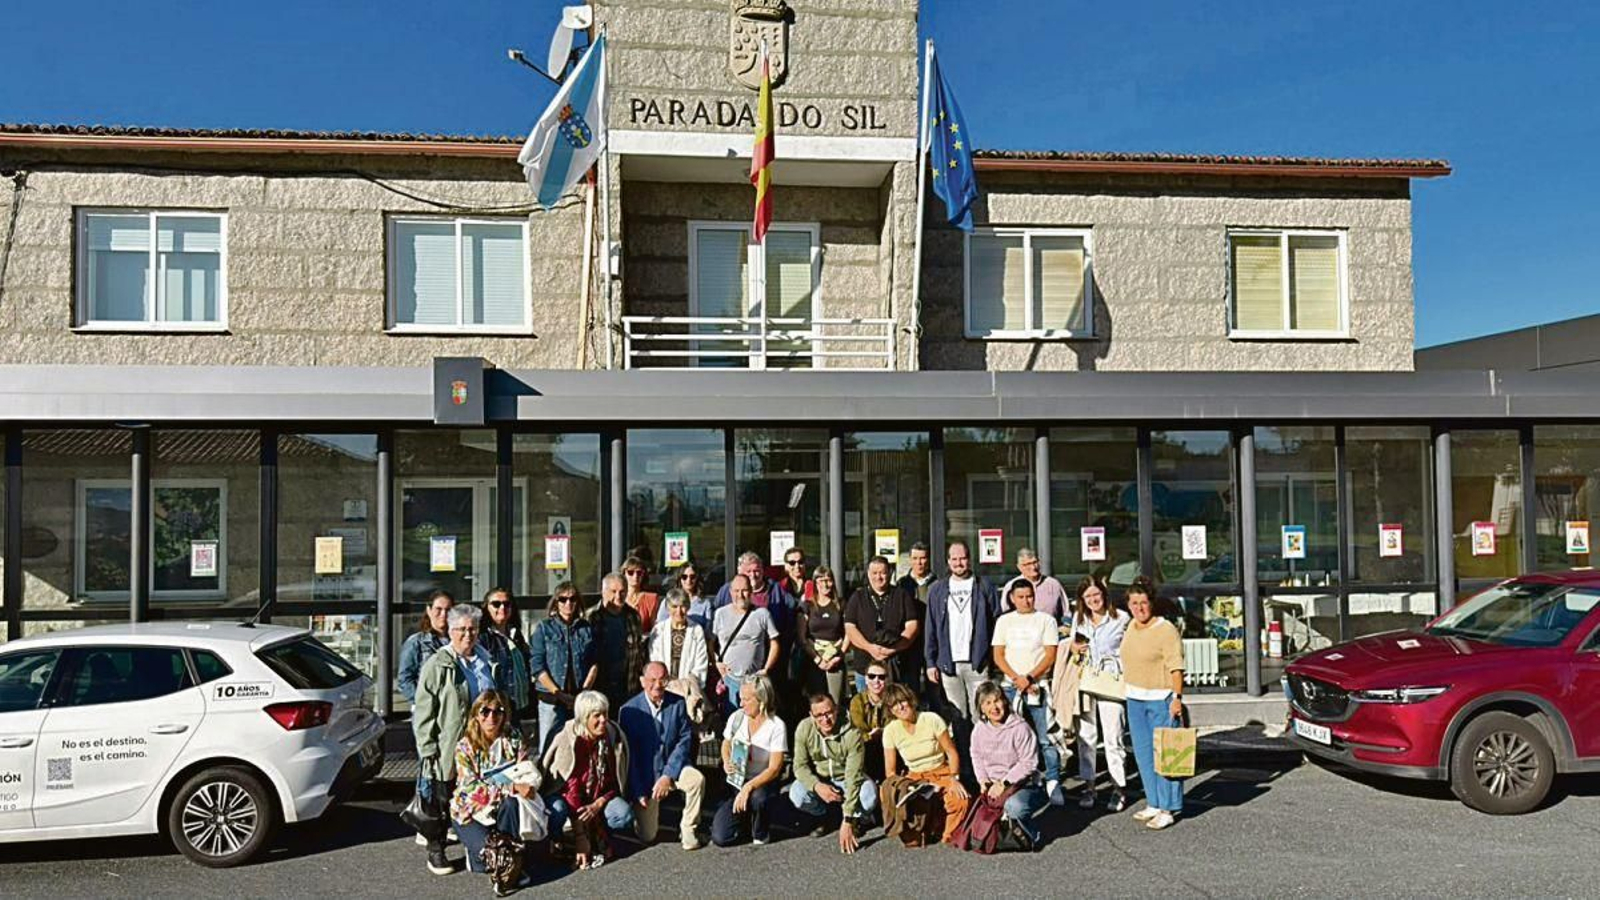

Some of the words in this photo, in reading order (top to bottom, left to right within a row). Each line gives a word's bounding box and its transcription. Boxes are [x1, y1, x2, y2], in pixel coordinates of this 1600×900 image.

[629, 98, 756, 127] PARADA
[779, 102, 822, 128] DO
[841, 105, 886, 130] SIL
[216, 686, 236, 697] 10
[61, 740, 77, 749] No
[78, 740, 92, 748] es
[93, 738, 104, 747] el
[94, 751, 105, 760] el
